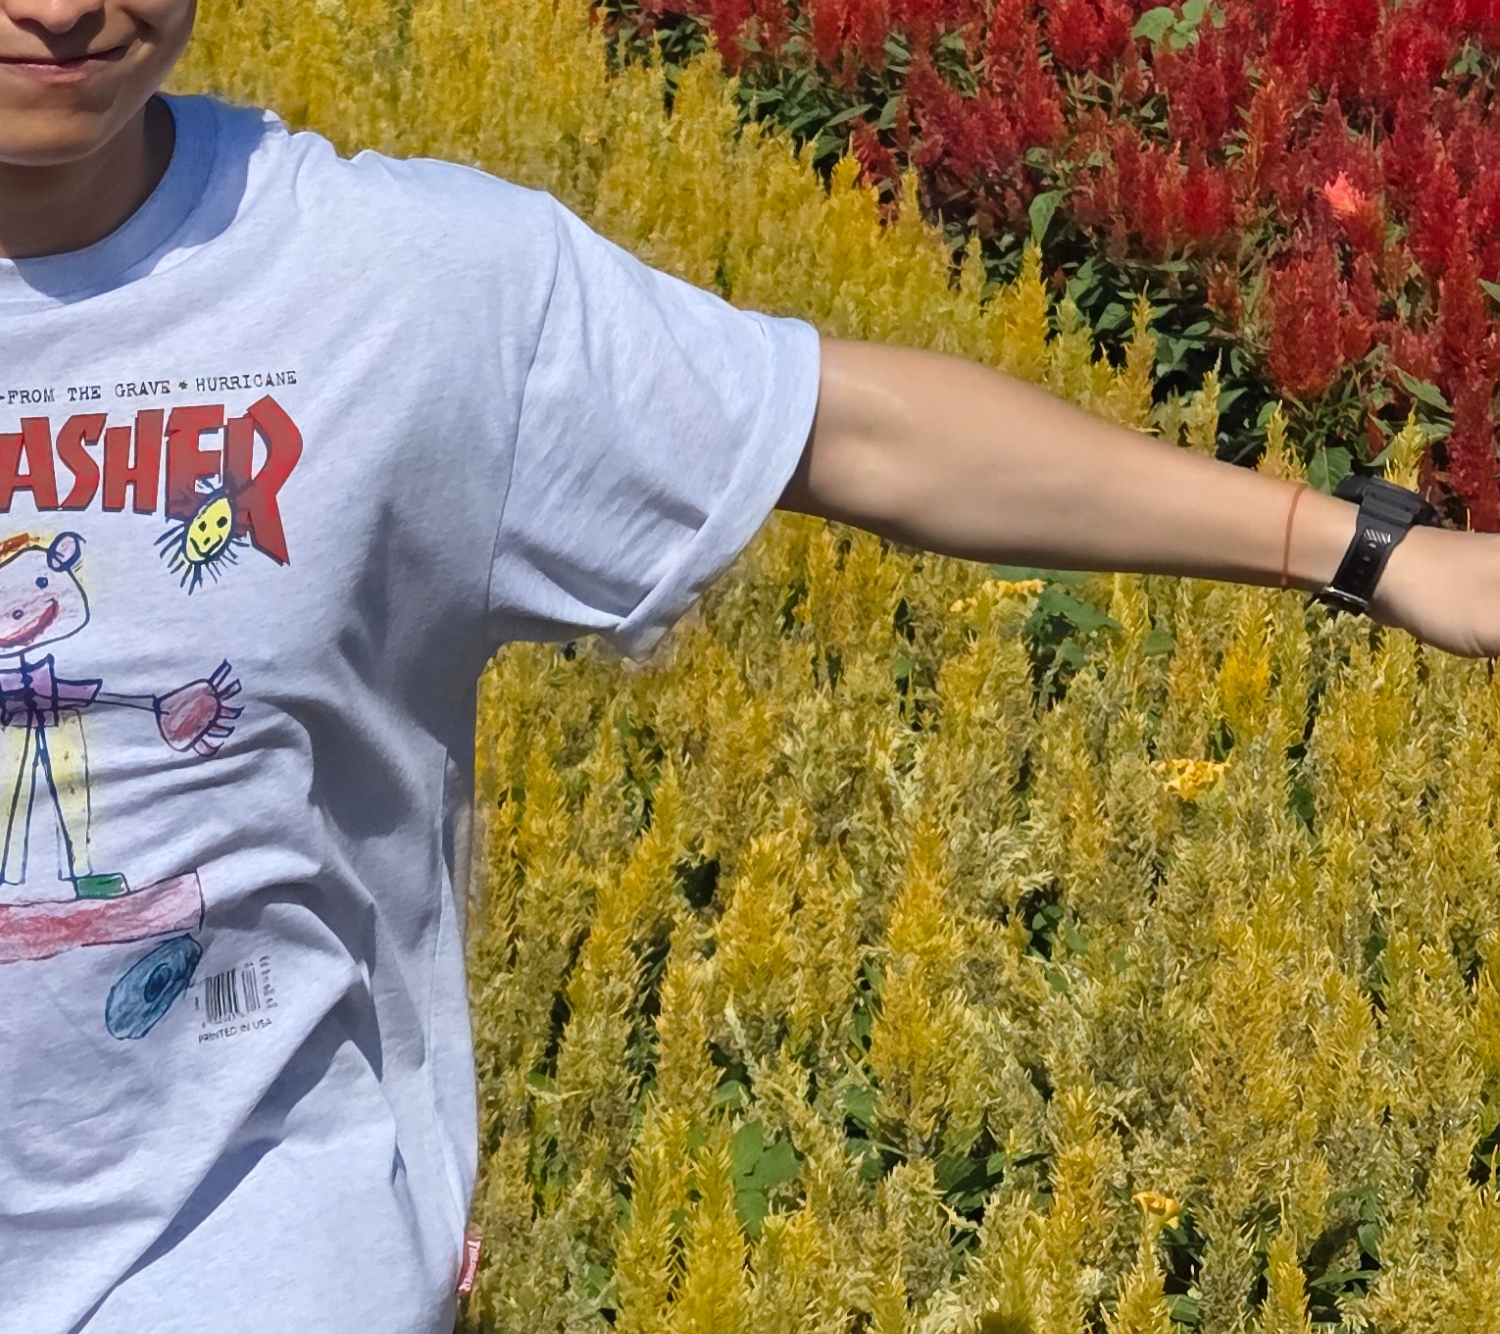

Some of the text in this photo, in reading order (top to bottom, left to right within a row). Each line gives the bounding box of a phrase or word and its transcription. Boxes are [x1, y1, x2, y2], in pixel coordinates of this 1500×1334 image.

[67, 385, 102, 402] THE
[114, 379, 171, 398] GRAVE
[195, 370, 298, 392] HURRICANE
[198, 1025, 238, 1045] PRINTED
